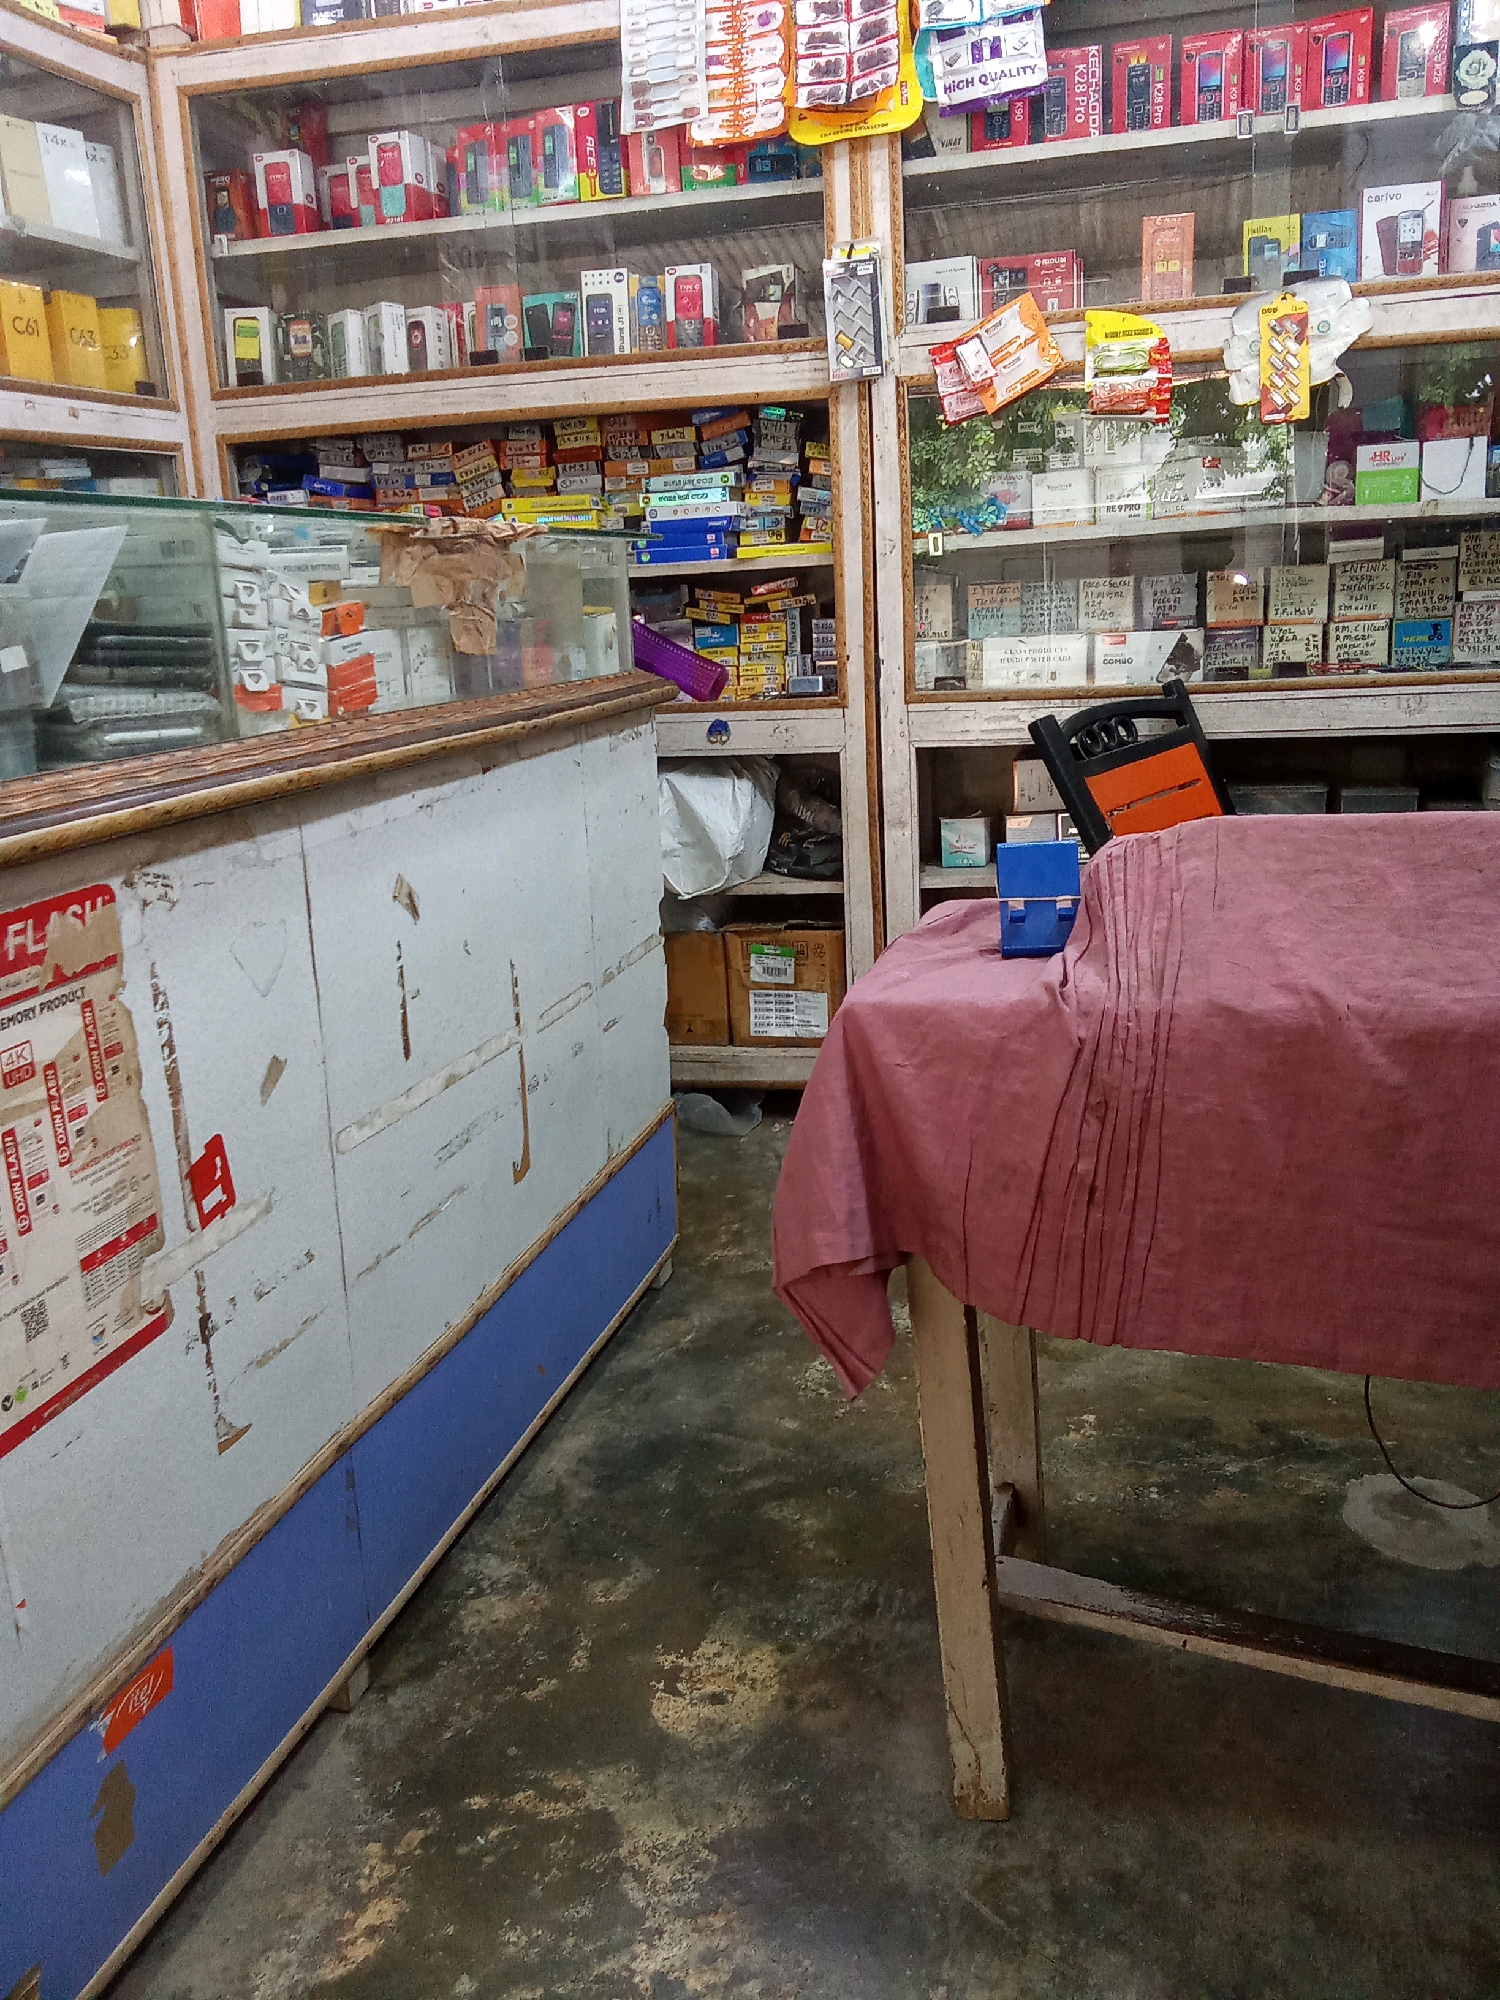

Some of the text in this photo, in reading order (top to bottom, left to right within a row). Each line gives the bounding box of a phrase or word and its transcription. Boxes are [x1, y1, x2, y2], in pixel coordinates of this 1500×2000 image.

[978, 64, 1038, 85] QUALITY
[1074, 64, 1087, 123] K28 Pro
[1088, 45, 1100, 137] KECHAODA
[1154, 82, 1164, 124] K28 Pro
[585, 136, 597, 168] ACE
[12, 316, 40, 338] C61
[1341, 561, 1389, 575] INFINIX
[1102, 657, 1134, 665] COMBO
[0, 986, 87, 1031] EMORY PRODUCT
[84, 1006, 99, 1049] FLASH
[5, 1046, 30, 1068] 4K
[53, 1114, 68, 1145] OXIN
[4, 1136, 27, 1213] OXIN FLASH
